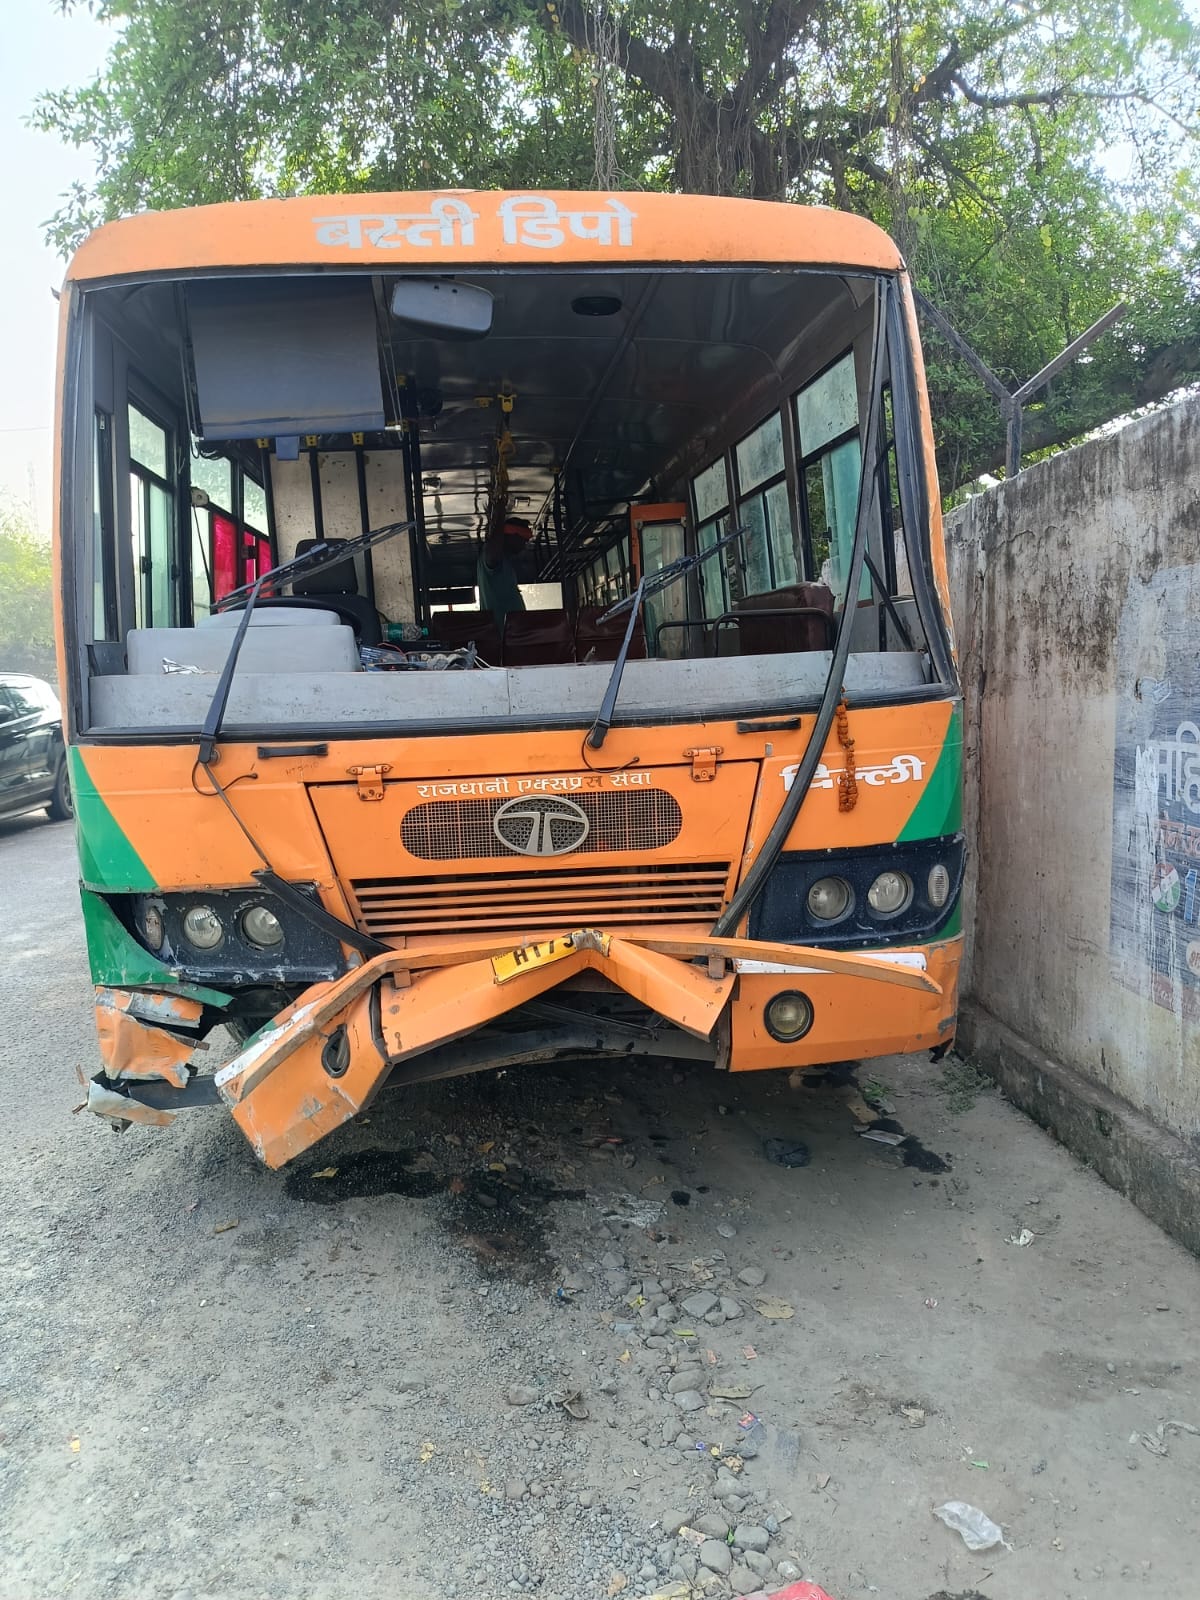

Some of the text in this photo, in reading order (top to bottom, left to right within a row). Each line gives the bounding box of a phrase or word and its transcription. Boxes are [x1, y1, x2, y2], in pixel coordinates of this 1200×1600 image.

[311, 195, 638, 249] बस्ती डिपो
[416, 777, 511, 798] राजधानी
